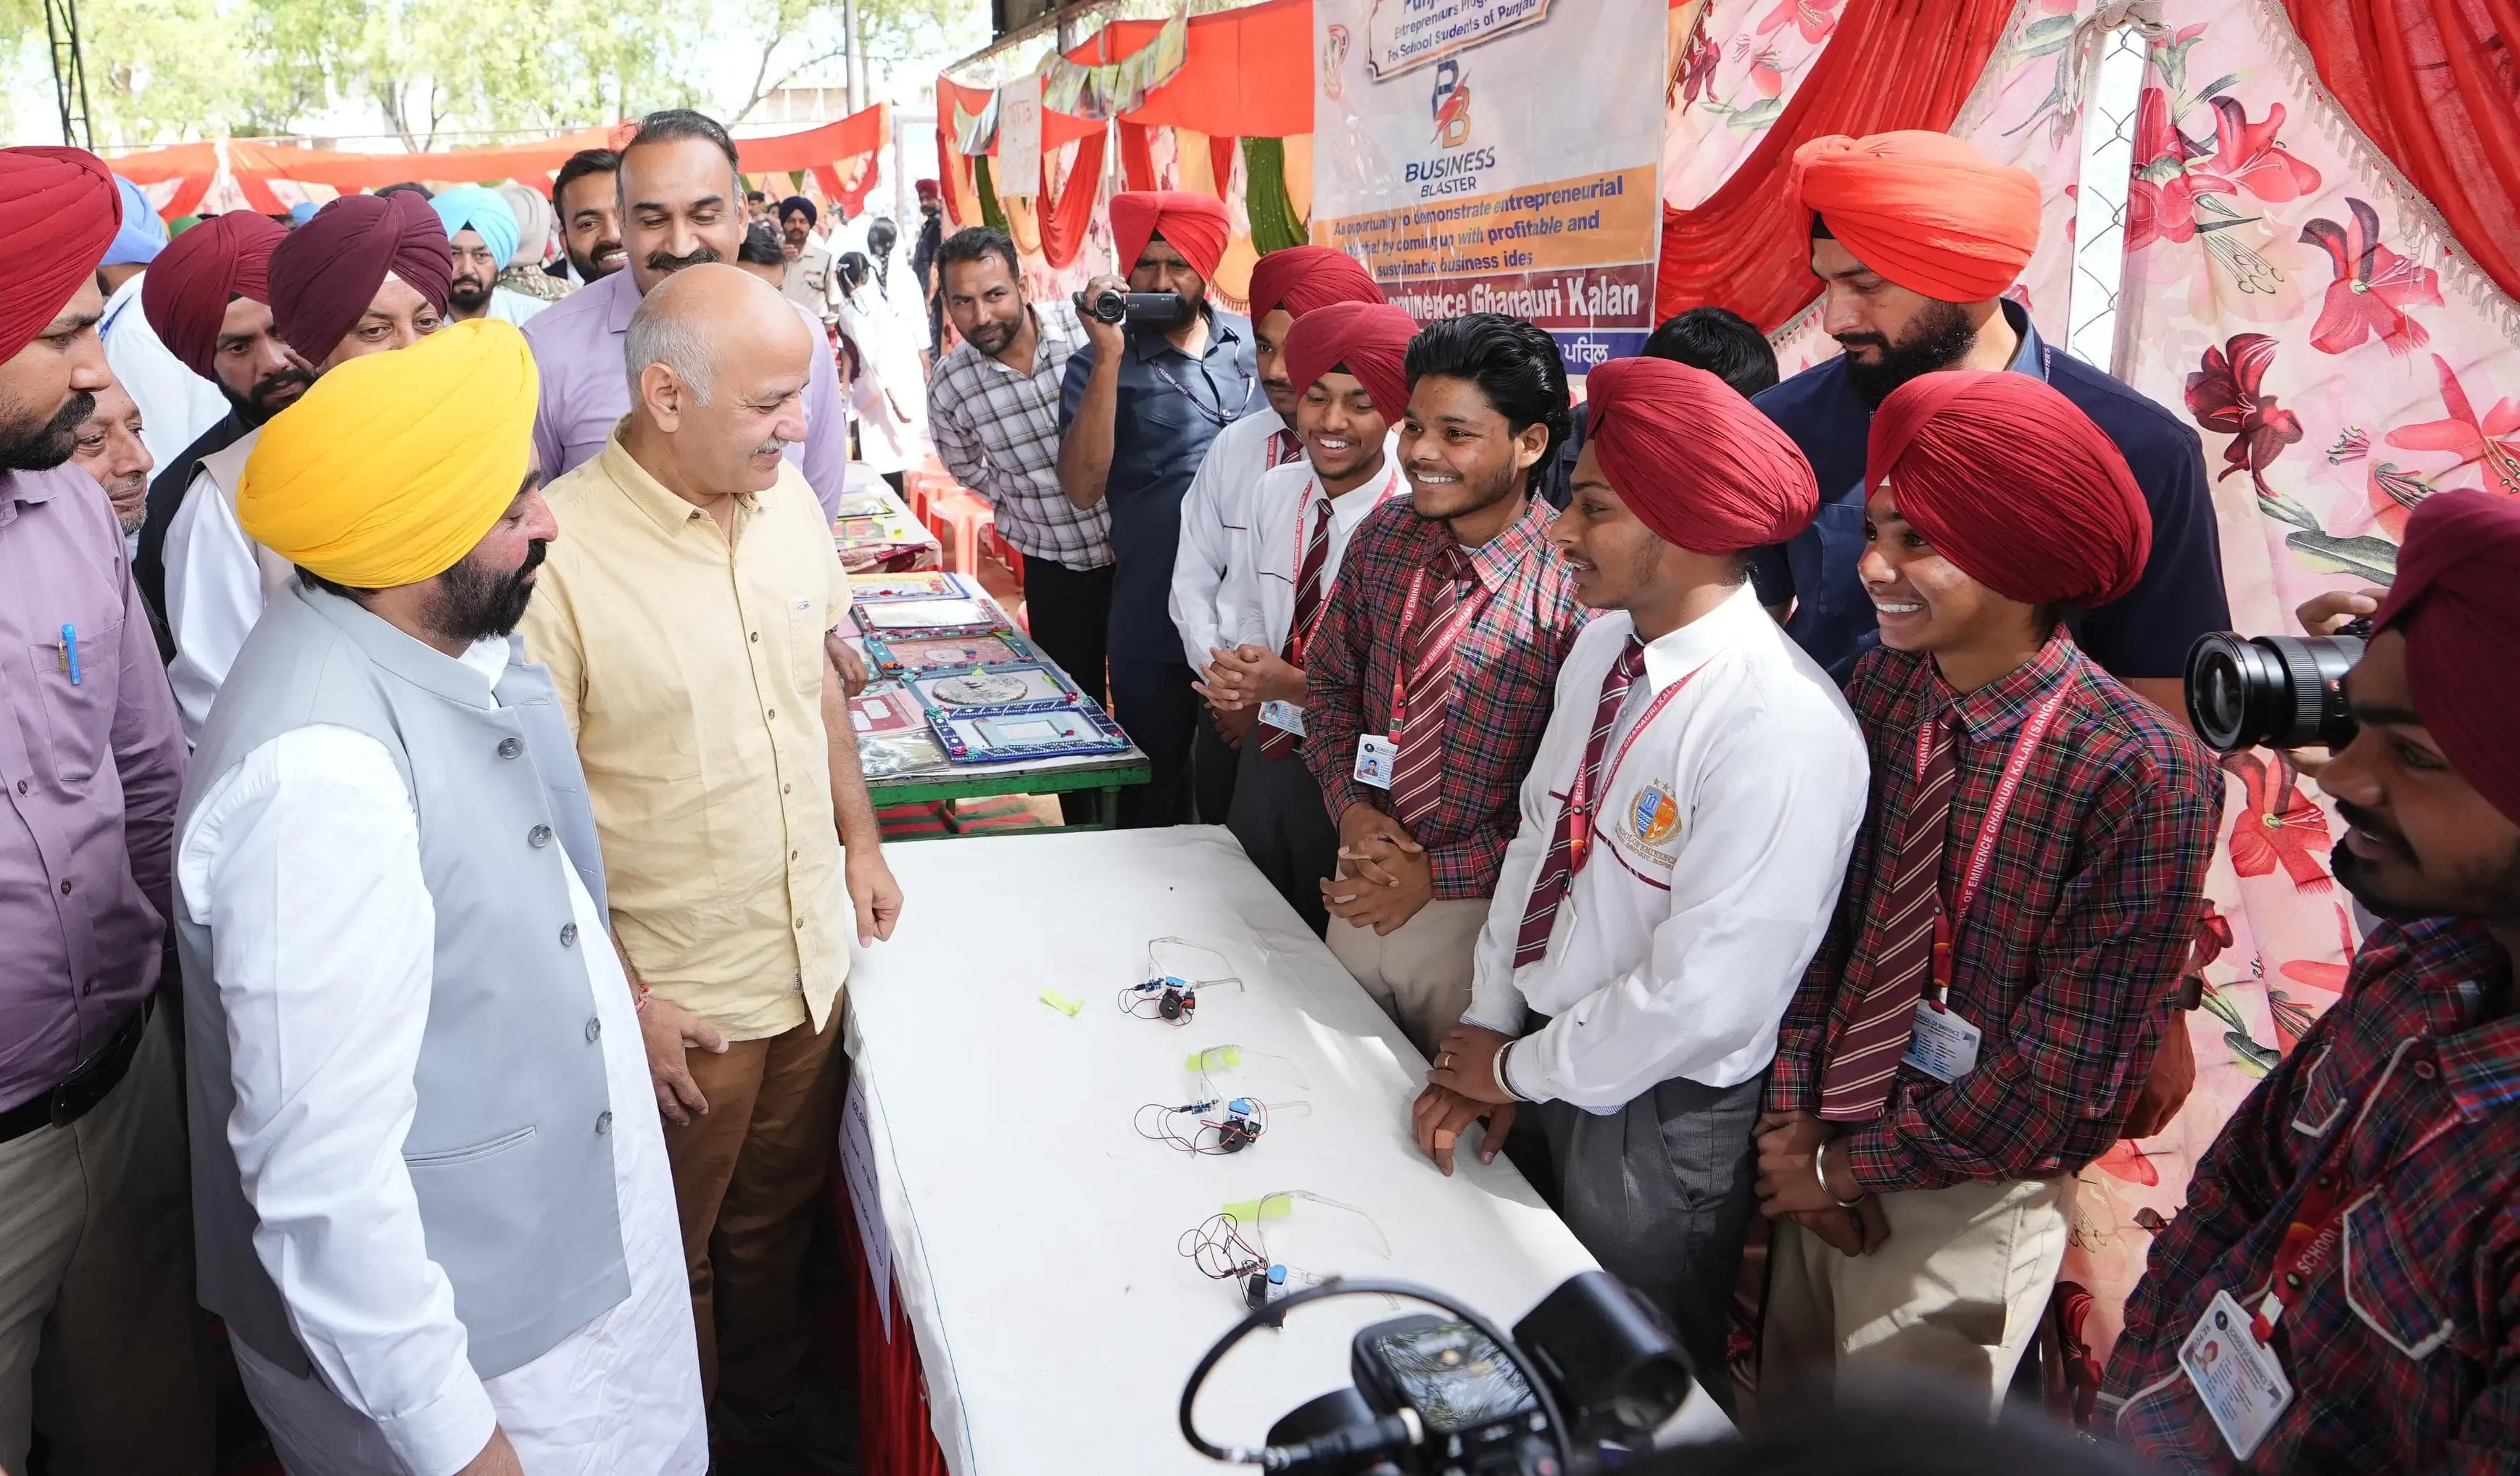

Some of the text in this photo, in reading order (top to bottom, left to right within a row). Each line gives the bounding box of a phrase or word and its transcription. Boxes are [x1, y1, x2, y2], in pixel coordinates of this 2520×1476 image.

[1400, 33, 1432, 57] School
[1483, 9, 1494, 26] of
[1405, 146, 1496, 182] BUSINESS
[1414, 199, 1491, 225] demonstrate
[1494, 175, 1623, 214] entrepreneurial
[1421, 176, 1476, 197] BLASTER
[1383, 239, 1394, 256] by
[1458, 226, 1483, 244] with
[1488, 216, 1563, 245] profitable
[1567, 210, 1599, 231] and
[1441, 254, 1499, 272] business
[1504, 249, 1533, 268] ides
[1470, 278, 1559, 318] Ghanauri
[1567, 275, 1639, 317] Kalan
[1563, 336, 1609, 363] ਪਹਿਲ
[1408, 567, 1425, 608] EMINENCE
[1405, 610, 1413, 621] OF
[1421, 659, 1431, 671] OF
[1427, 626, 1457, 662] EMINENCE
[1454, 590, 1487, 628] GHANAURI
[1623, 705, 1658, 748] GHANAURI
[1919, 719, 1933, 775] GHANAUR
[2010, 738, 2036, 776] KALAN
[1986, 776, 2017, 834] GHANAURI
[1968, 834, 1994, 887] EMINENCE
[1964, 890, 1974, 903] OF
[2297, 1228, 2339, 1274] SCHOOL
